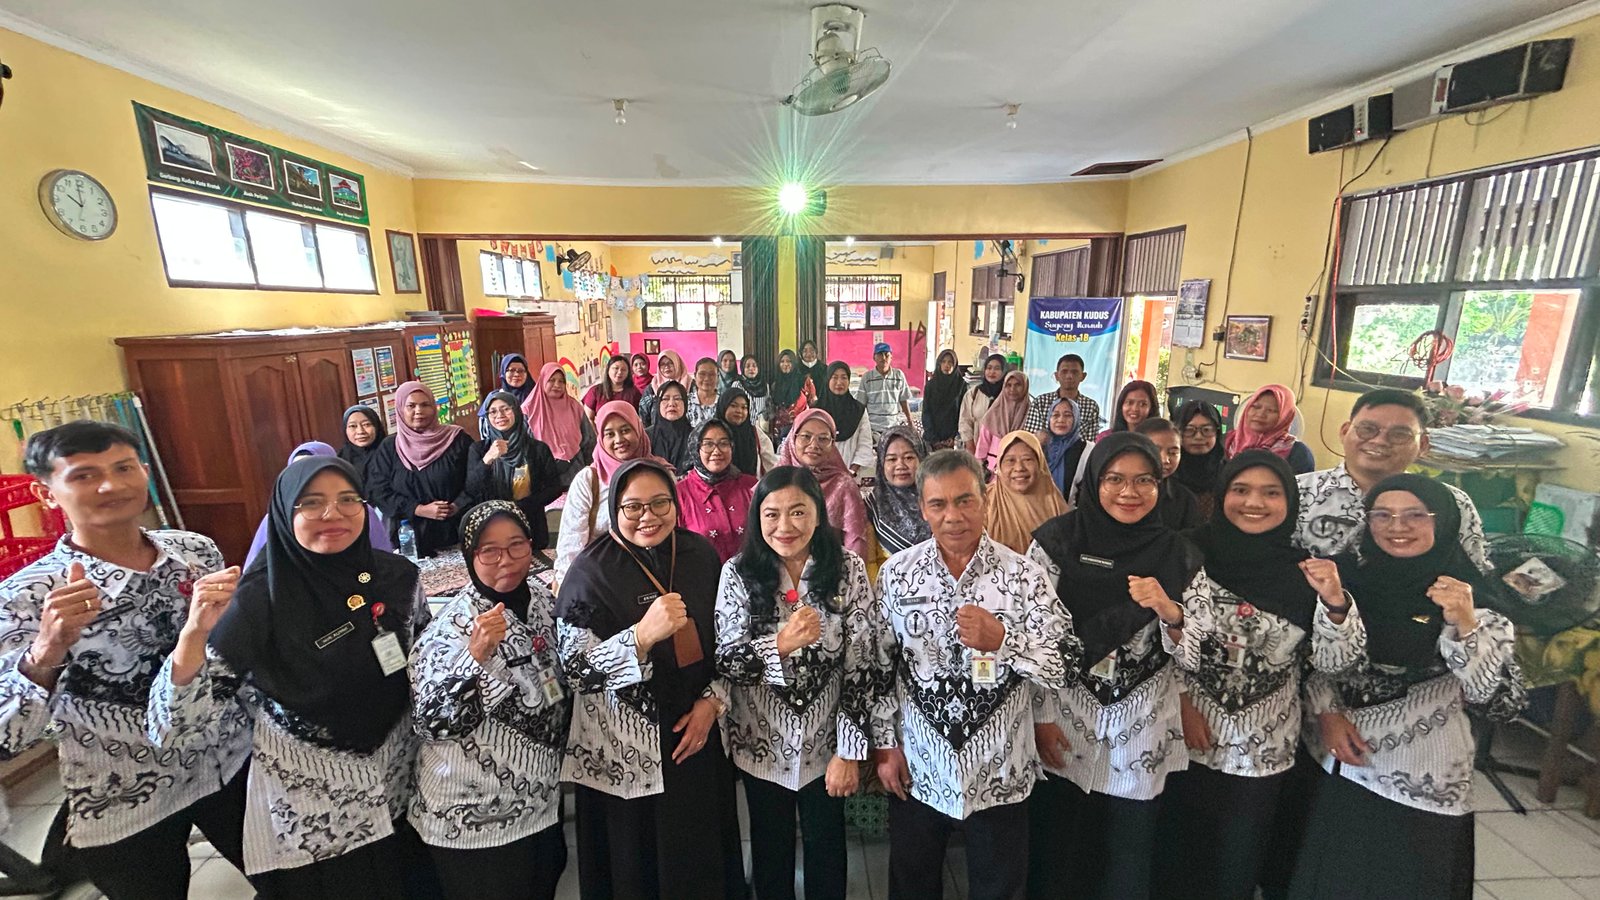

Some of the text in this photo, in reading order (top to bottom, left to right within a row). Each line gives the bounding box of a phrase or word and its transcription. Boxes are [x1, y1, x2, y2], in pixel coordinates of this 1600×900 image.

[1040, 310, 1110, 320] KABUPATEN KUDUS
[1044, 321, 1074, 332] Sugeng
